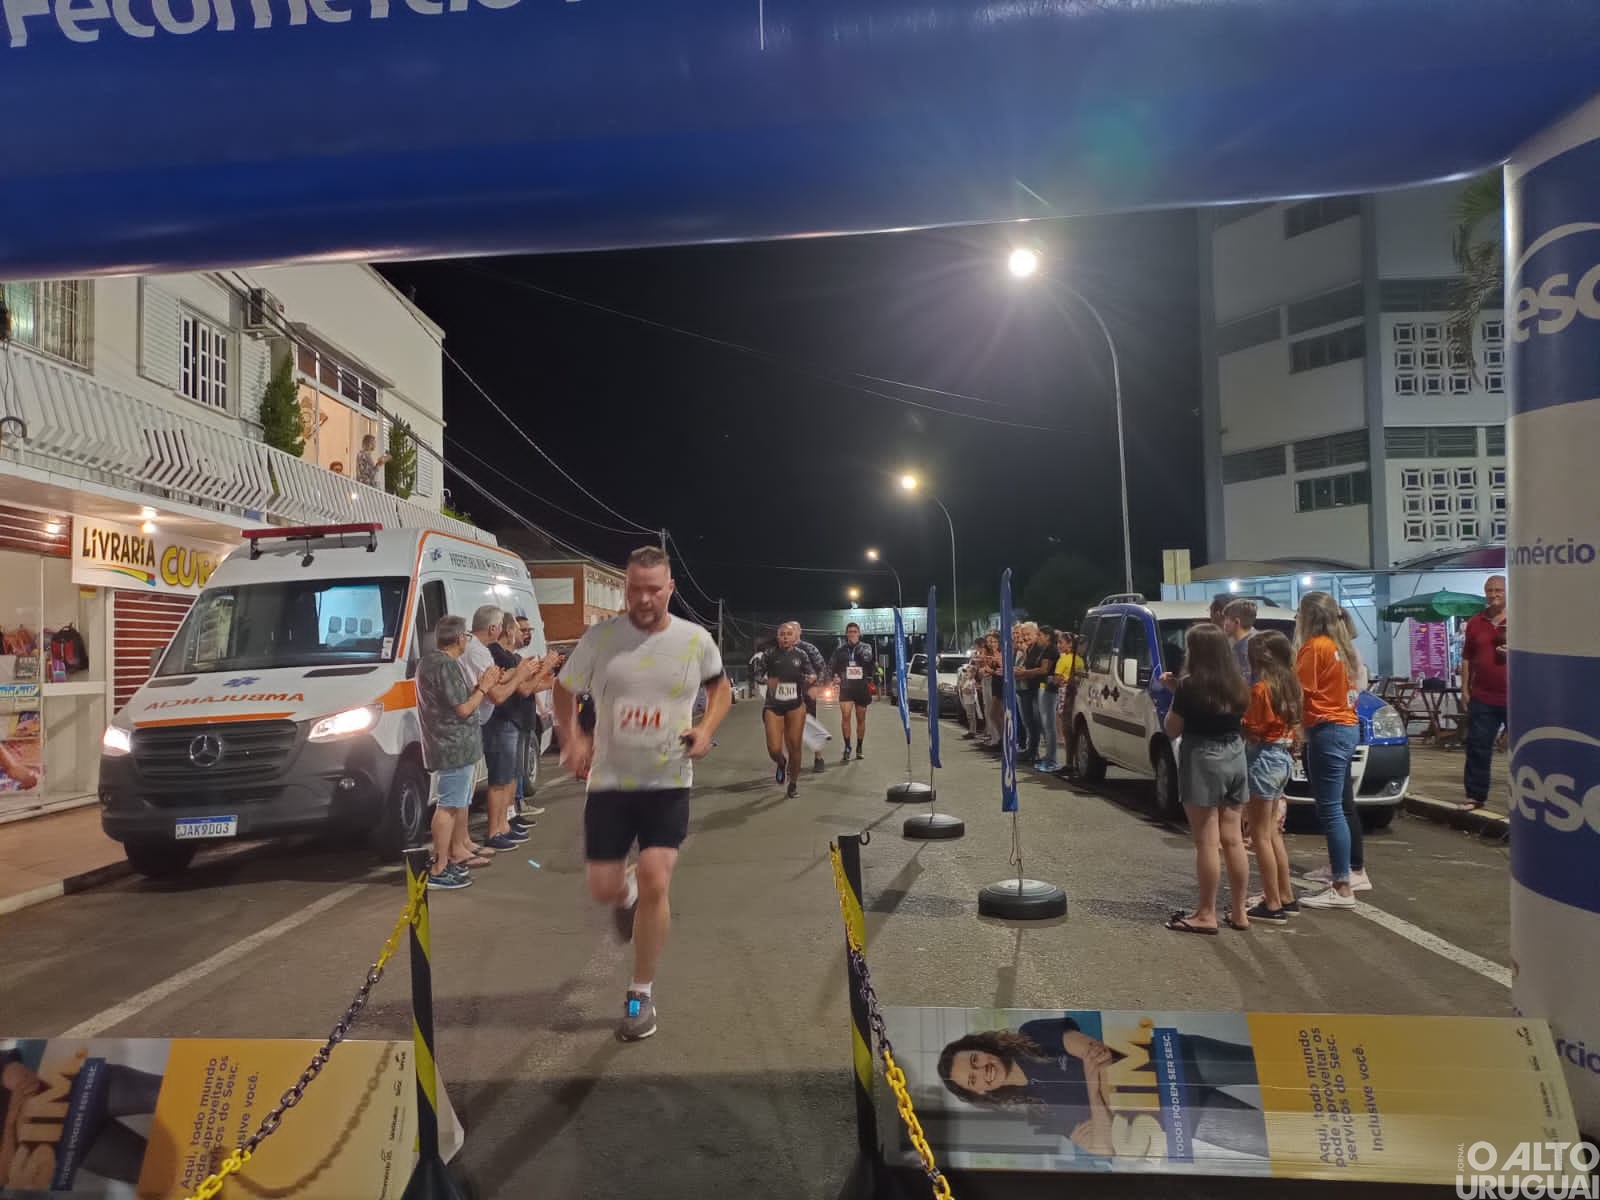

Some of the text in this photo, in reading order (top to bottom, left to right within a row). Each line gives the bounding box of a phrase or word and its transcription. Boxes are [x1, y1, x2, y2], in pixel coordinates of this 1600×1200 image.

[179, 1057, 217, 1190] Aqui, todo mundo
[202, 1075, 225, 1149] aproveitar
[217, 1055, 230, 1072] os
[218, 1102, 231, 1122] do
[1166, 1060, 1177, 1080] SER
[1168, 1082, 1182, 1119] PODEM
[1298, 1029, 1332, 1164] Aqui, todo mundo
[1311, 1027, 1348, 1168] pode aproveitar os
[1327, 1034, 1358, 1162] serviços do Sesc.
[1351, 1043, 1385, 1152] Inclusive você.
